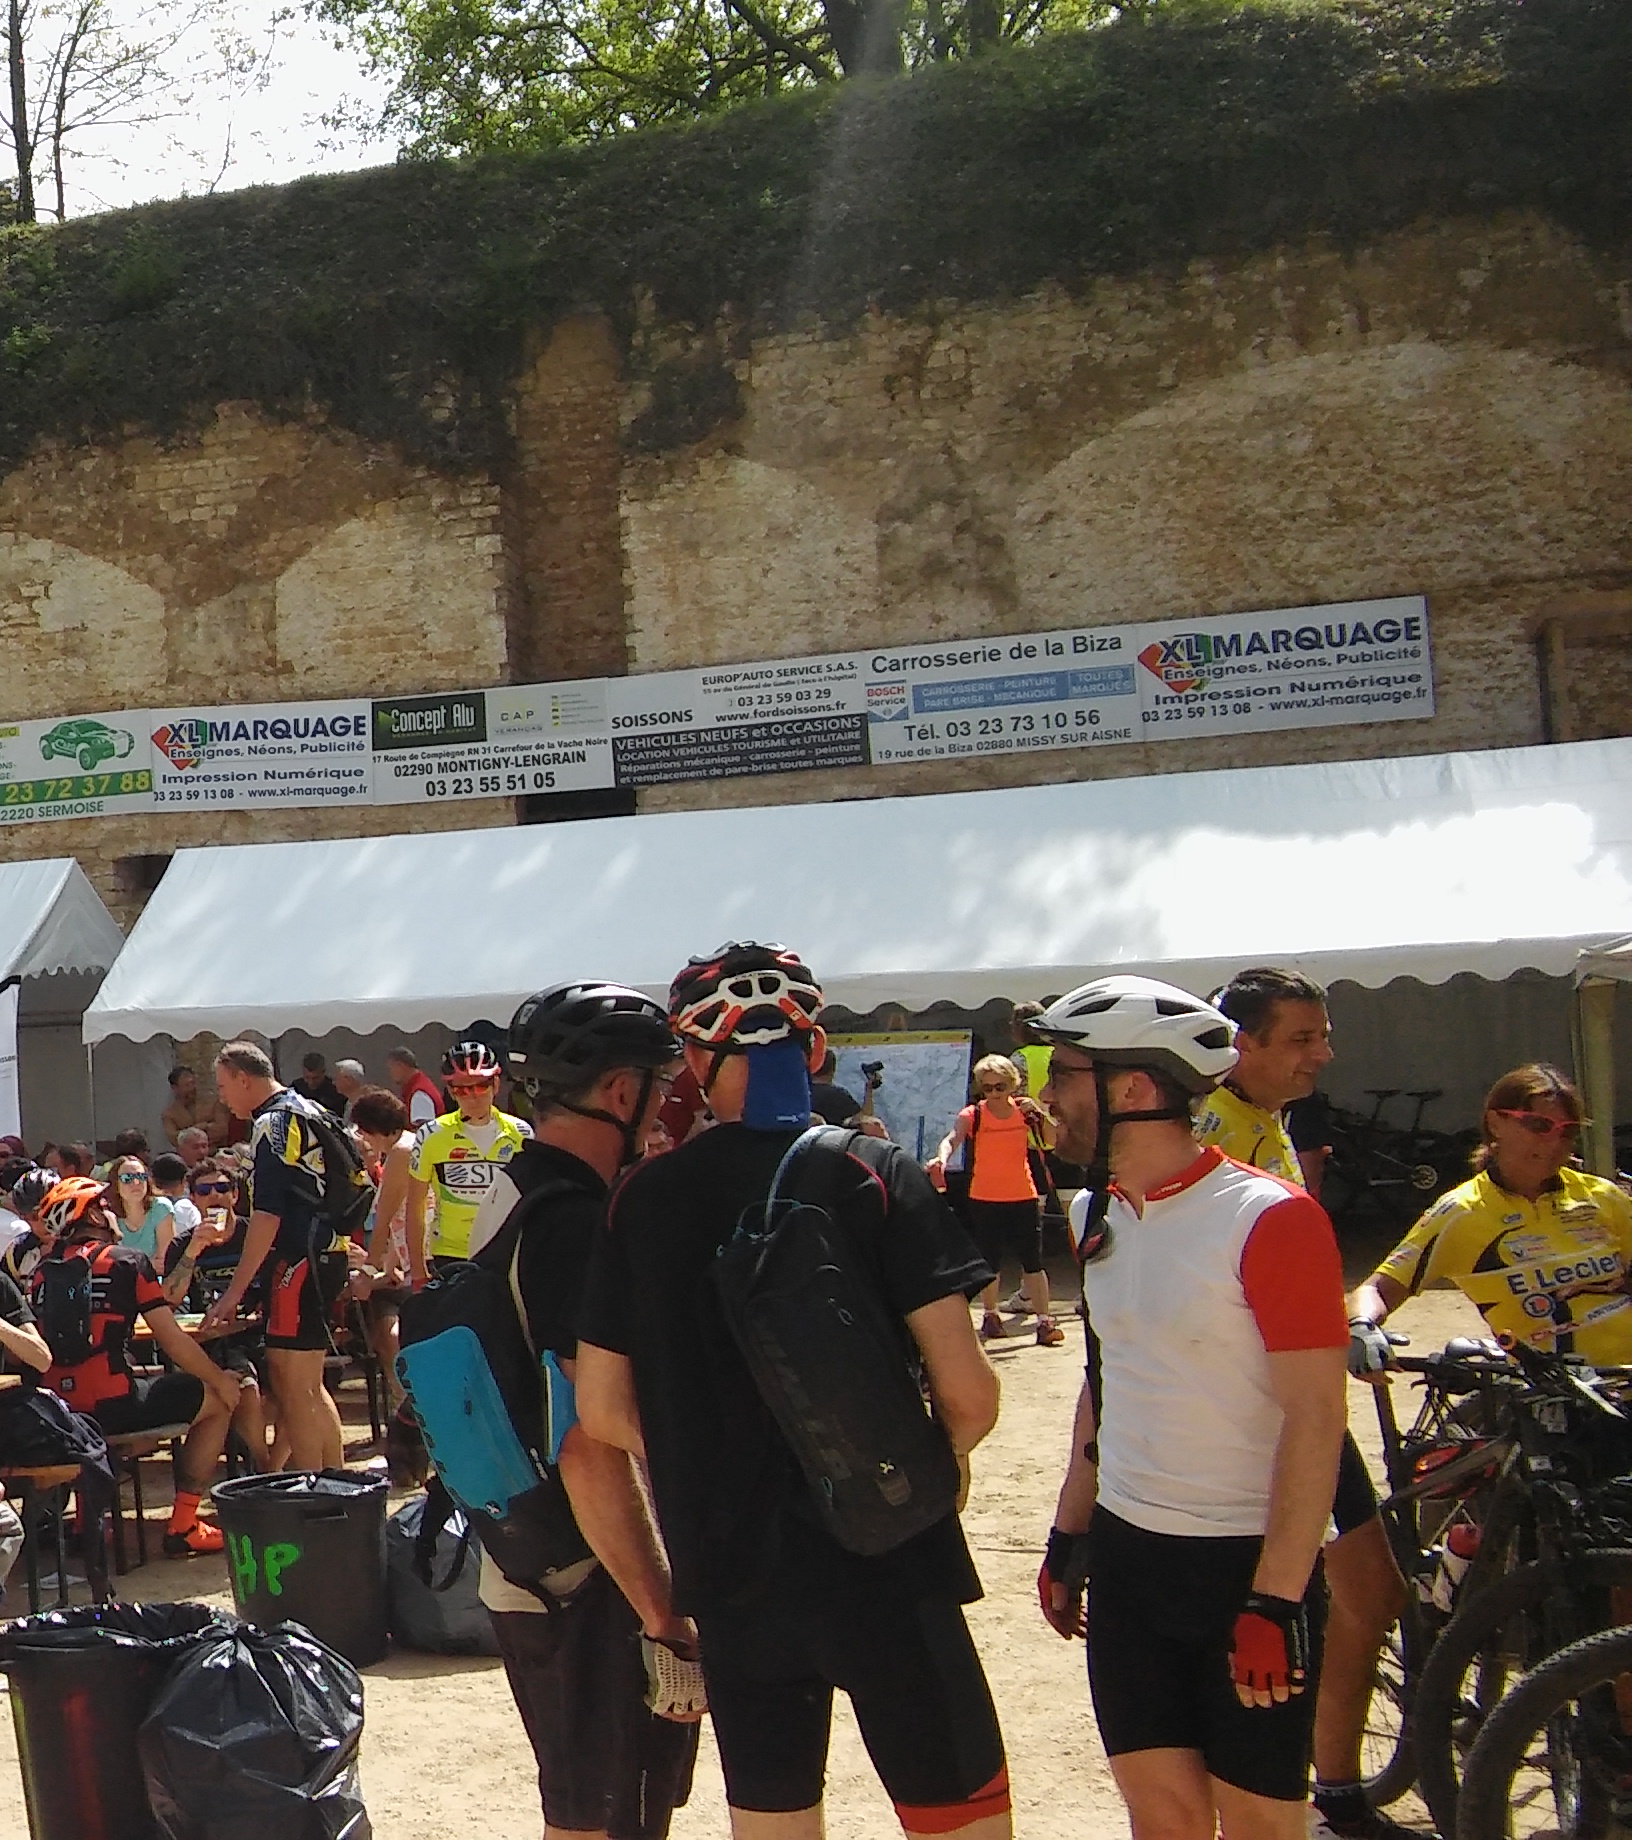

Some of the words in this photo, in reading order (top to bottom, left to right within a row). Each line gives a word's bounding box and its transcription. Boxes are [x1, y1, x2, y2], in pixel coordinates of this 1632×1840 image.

[1158, 638, 1203, 664] XL
[1214, 616, 1421, 660] MARQUAGE
[871, 646, 1002, 674] Carrosserie
[1009, 642, 1037, 660] de
[1044, 638, 1064, 656] la
[1072, 635, 1123, 654] Biza
[1163, 663, 1263, 681] Enseignes,
[1267, 656, 1332, 671] Néons,
[1336, 647, 1421, 665] Publicité
[702, 670, 773, 686] EUROP'AUTO
[776, 665, 823, 678] SERVICE
[826, 661, 858, 673] S.A.S.
[921, 682, 995, 697] CARROSSERIE
[1004, 676, 1057, 689] PEINTURE
[1079, 669, 1124, 681] TOUTES
[737, 696, 754, 707] 03
[757, 694, 773, 705] 23
[776, 692, 792, 703] 59
[795, 690, 811, 701] 03
[815, 688, 831, 699] 29
[867, 686, 905, 698] BOSCH
[924, 698, 950, 707] PARE
[953, 694, 985, 706] BRISE
[994, 688, 1057, 701] MECANIQUE
[1072, 680, 1131, 694] MARQUES
[1154, 684, 1281, 706] Impression
[1290, 672, 1423, 694] Numérique
[715, 701, 846, 723] www.fordsoissons.fr
[867, 697, 906, 707] Service
[1142, 709, 1160, 723] 03
[1164, 707, 1183, 721] 23
[1187, 706, 1205, 719] 59
[1211, 704, 1229, 717] 13
[1232, 702, 1251, 716] 08
[1270, 687, 1428, 711] www.xl-marquage.fr
[168, 722, 200, 744] XL
[208, 715, 367, 742] MARQUAGE
[391, 704, 447, 735] Concept
[452, 703, 475, 727] Alu
[611, 709, 693, 730] SOISSONS
[903, 723, 941, 742] Tél.
[946, 721, 971, 738] 03
[978, 717, 1003, 735] 23
[1010, 715, 1035, 732] 73
[1041, 711, 1068, 729] 10
[1075, 709, 1101, 727] 56
[616, 732, 696, 751] VEHICULES
[700, 727, 748, 743] NEUFS
[752, 726, 768, 738] et
[770, 716, 861, 736] OCCASIONS
[617, 750, 670, 762] LOCATION
[672, 743, 730, 756] VEHICULES
[732, 738, 788, 751] TOURISME
[790, 737, 801, 746] et
[803, 731, 861, 745] UTILITAIRE
[878, 749, 892, 759] 19
[895, 749, 914, 758] rue
[917, 747, 931, 756] de
[935, 745, 945, 755] la
[948, 743, 973, 754] Biza
[976, 739, 1013, 751] 02880
[1016, 734, 1057, 748] MISSY
[1061, 732, 1088, 744] SUR
[1091, 728, 1132, 741] AISNE
[247, 744, 297, 757] Néons,
[300, 742, 365, 754] Publicité
[384, 755, 406, 763] Route
[482, 746, 491, 754] 31
[494, 744, 533, 753] Carrefour
[557, 739, 583, 748] Vache
[586, 738, 608, 746] Noire
[620, 761, 681, 774] Réparations
[684, 754, 741, 767] mécanique
[749, 748, 806, 761] carrosserie
[815, 744, 861, 756] peinture
[394, 763, 433, 777] 02290
[438, 750, 586, 774] MONTIGNY-LENGRAIN
[620, 776, 631, 785] et
[633, 769, 707, 783] remplacement
[709, 767, 723, 776] de
[725, 763, 777, 776] pare-brise
[779, 759, 814, 770] toutes
[816, 755, 863, 766] marques
[5, 783, 33, 804] 23
[44, 779, 73, 800] 72
[81, 775, 110, 797] 37
[120, 771, 150, 792] 88
[162, 771, 257, 786] Impression
[263, 768, 365, 781] Numérique
[425, 780, 446, 796] 03
[452, 778, 474, 795] 23
[480, 776, 501, 793] 55
[507, 774, 526, 791] 51
[533, 771, 555, 788] 05
[169, 791, 182, 800] 23
[186, 790, 200, 800] 59
[204, 789, 217, 800] 13
[221, 789, 235, 799] 08
[248, 784, 368, 797] www.xl-marquage.fr
[37, 801, 104, 818] SERMOISE
[228, 1532, 299, 1604] HP
